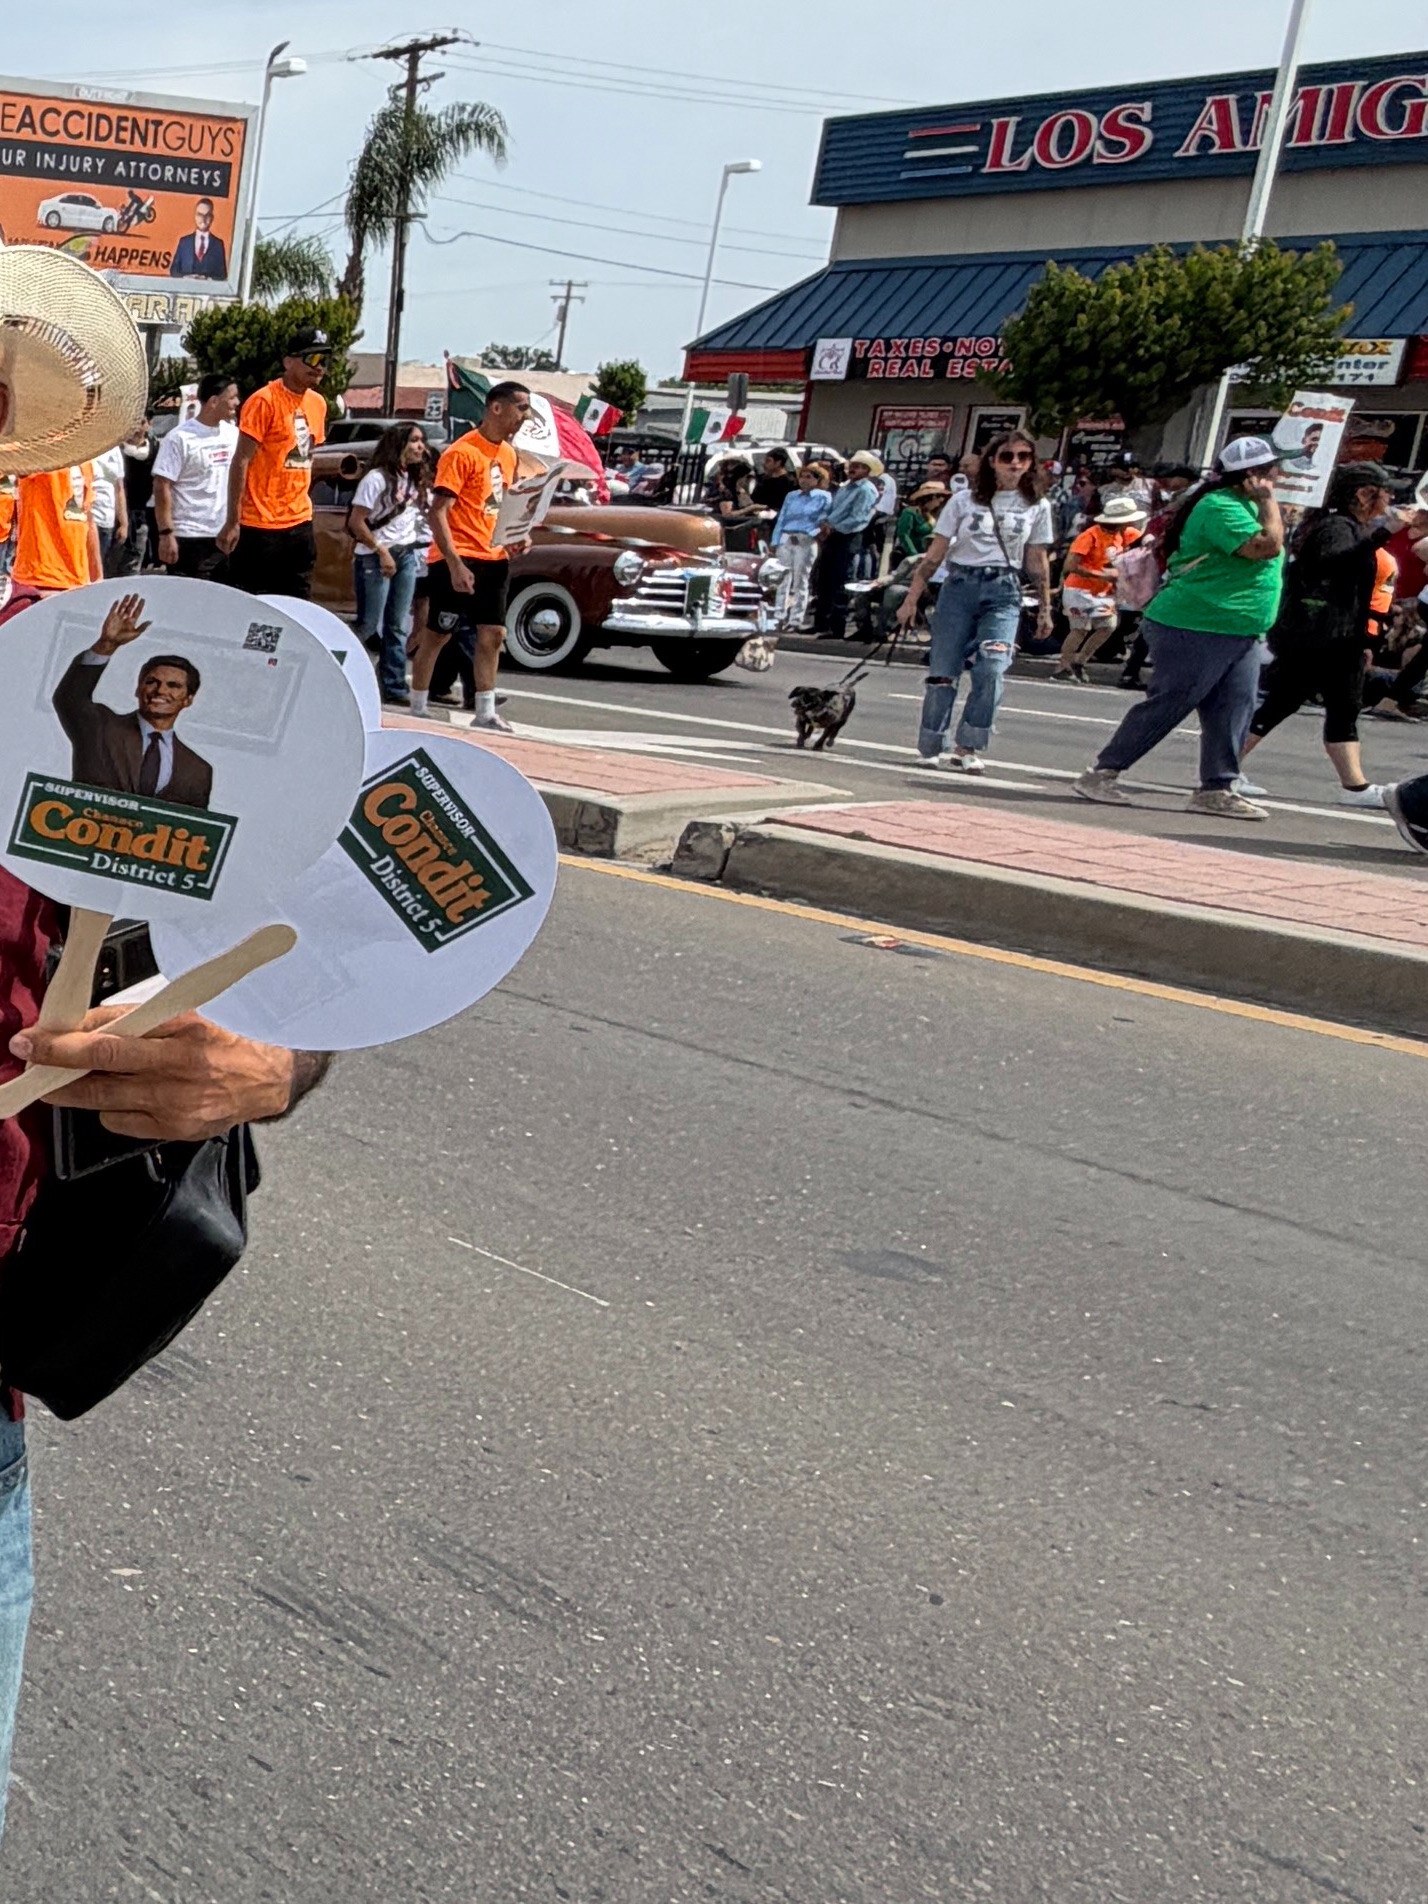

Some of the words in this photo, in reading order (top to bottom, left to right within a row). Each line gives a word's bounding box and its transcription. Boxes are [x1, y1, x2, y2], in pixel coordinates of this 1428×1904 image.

[982, 101, 1153, 174] LOS
[36, 151, 106, 175] INJURY
[115, 160, 221, 188] ATTORNEYS
[94, 246, 172, 270] HAPPENS
[853, 337, 941, 358] TAXES
[866, 359, 934, 378] REAL
[44, 782, 141, 812] SUPERVISOR
[415, 766, 476, 839] SUPERVISOR
[29, 800, 211, 872] Condit
[363, 782, 492, 925] Condit
[90, 852, 176, 887] District
[181, 874, 197, 890] 5
[370, 854, 430, 923] District
[419, 917, 444, 934] 5
